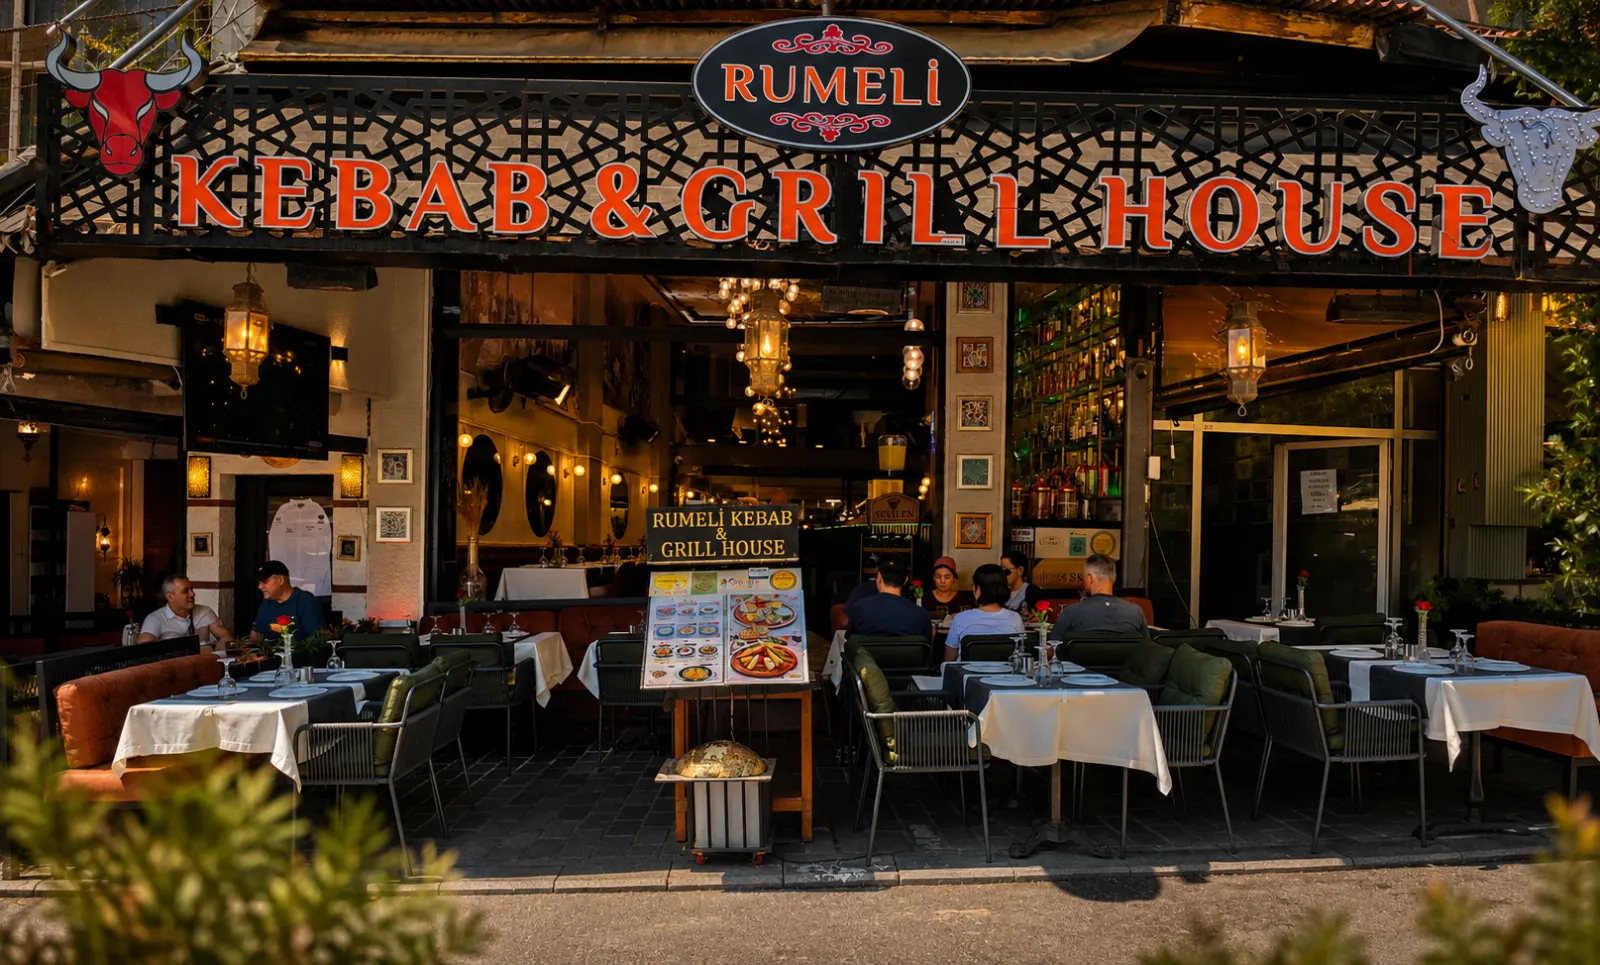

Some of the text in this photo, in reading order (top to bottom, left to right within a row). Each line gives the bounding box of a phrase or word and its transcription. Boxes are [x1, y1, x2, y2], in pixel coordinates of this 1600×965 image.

[171, 155, 1495, 260] KEBAB & GRILL HOUSE
[731, 510, 793, 527] KEBAB
[715, 527, 728, 541] &
[661, 539, 785, 558] GRILL HOUSE
